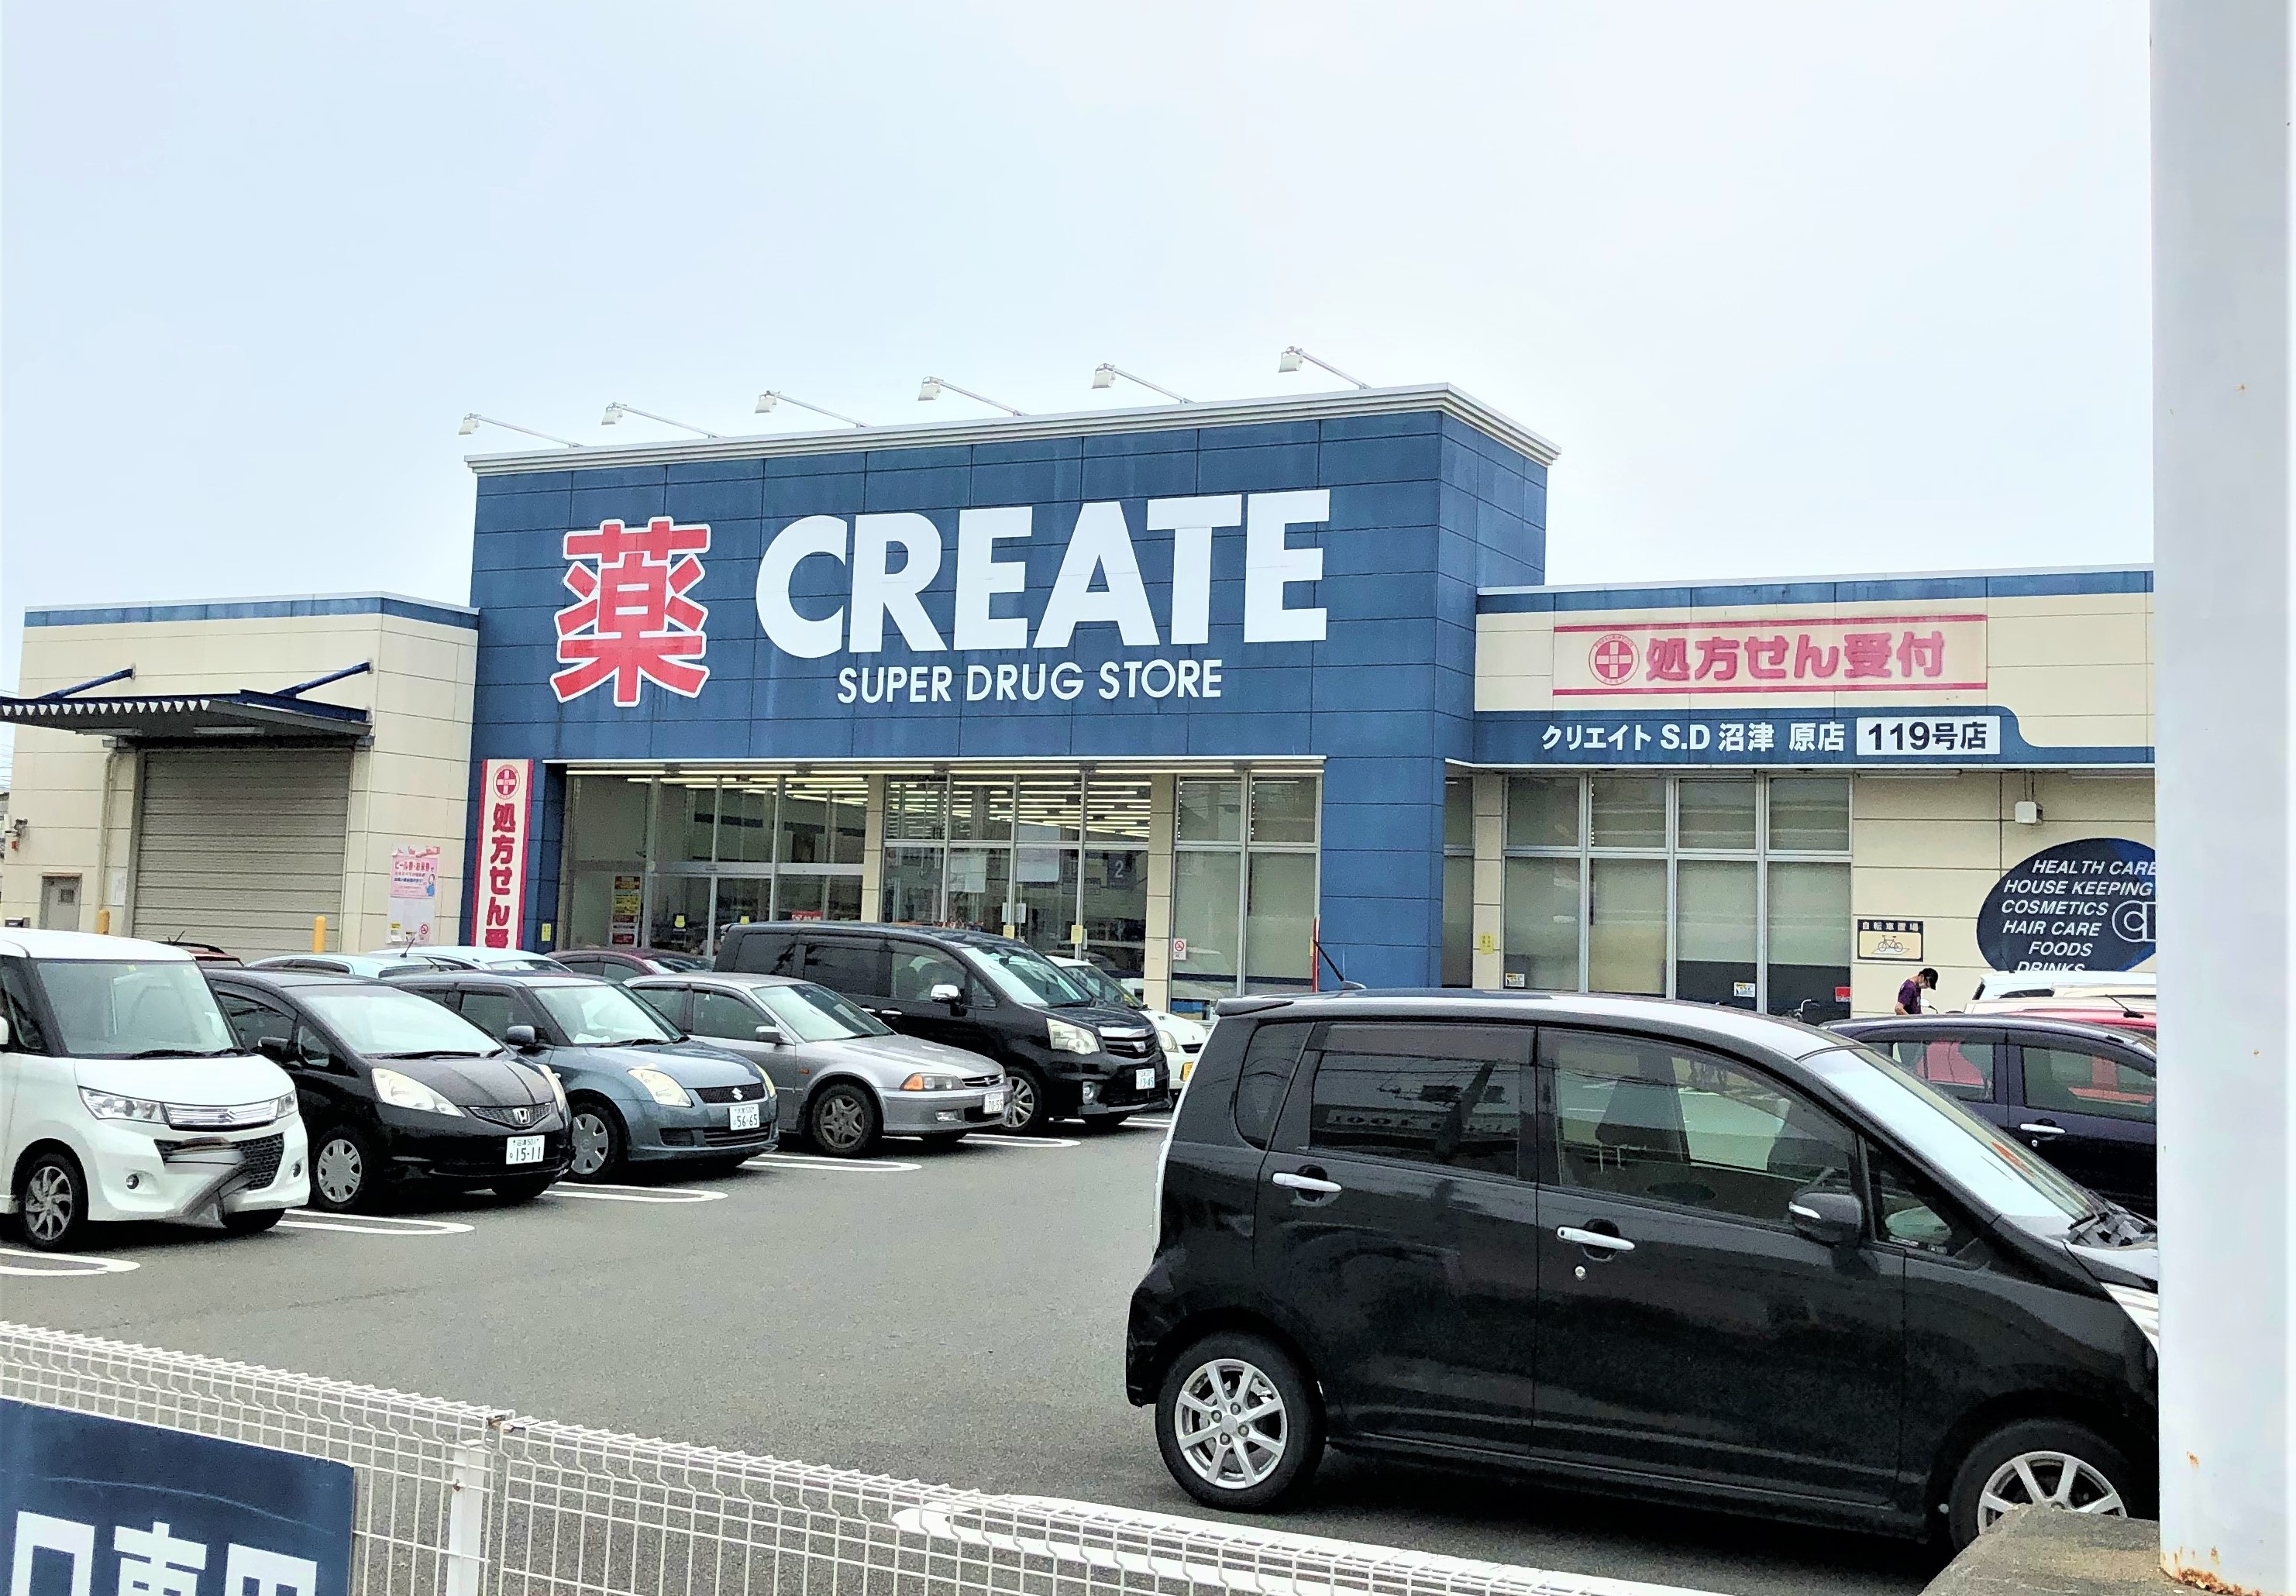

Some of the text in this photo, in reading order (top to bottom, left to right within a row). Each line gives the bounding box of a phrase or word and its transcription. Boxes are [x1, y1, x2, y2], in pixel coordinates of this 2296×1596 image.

[756, 489, 1330, 659] CREATE
[549, 515, 711, 707] 薬
[1645, 630, 1946, 683] 処方せん受付
[837, 659, 1223, 704] SUPER DRUG STORE
[1541, 721, 1988, 752] クリエイト S.D 沼津 原店 119号店
[2031, 859, 2157, 876] HEALTH CARE
[2003, 879, 2153, 896] HOUSE KEEPING
[2001, 899, 2109, 917] COSMETICS
[2002, 920, 2102, 937] HAIR CARE
[2028, 941, 2094, 957] FOODS
[2017, 961, 2085, 972] DRINKS
